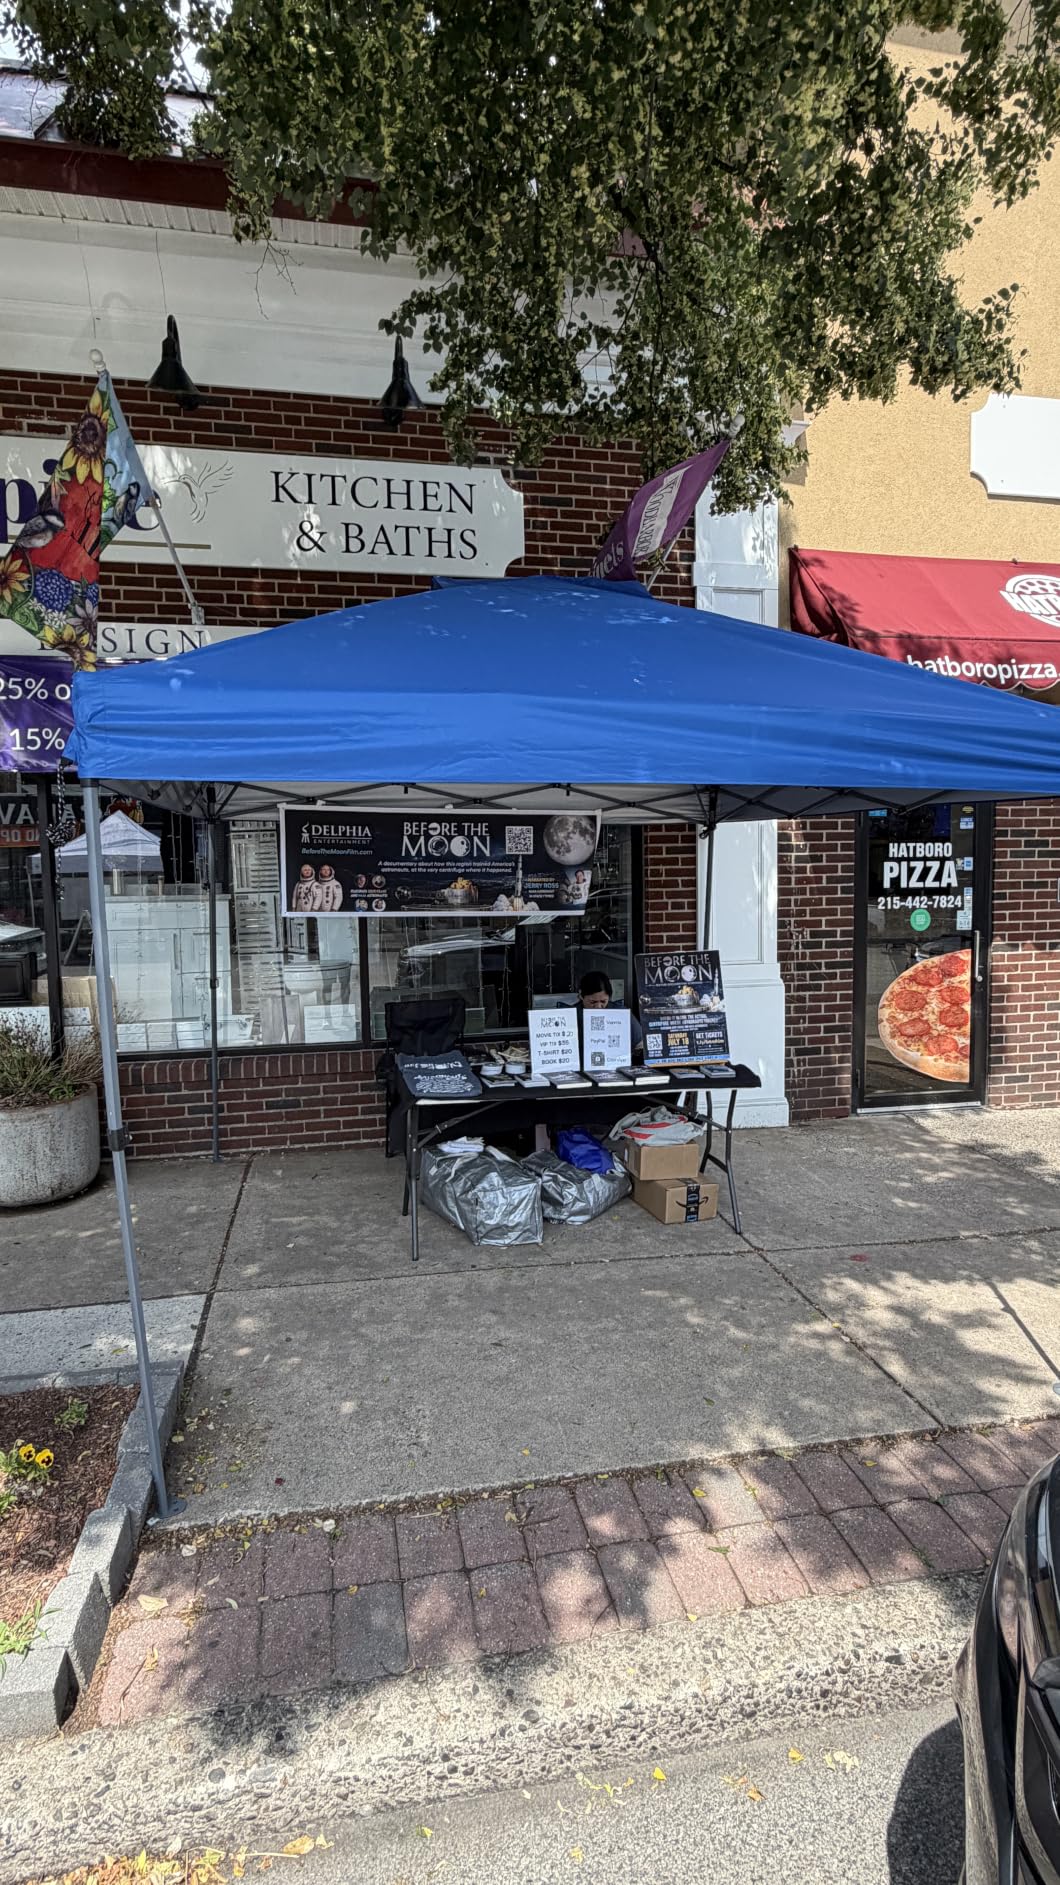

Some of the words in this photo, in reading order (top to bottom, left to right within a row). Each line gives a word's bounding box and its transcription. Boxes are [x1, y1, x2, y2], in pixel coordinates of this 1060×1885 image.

[270, 470, 477, 515] KITCHEN
[296, 520, 327, 553] &
[341, 522, 478, 560] BATHS
[9, 727, 66, 751] 15%
[311, 824, 372, 837] DELPHIA
[403, 822, 459, 836] BEFORE
[462, 822, 490, 836] THE
[401, 835, 491, 857] MOON
[888, 842, 953, 858] HATBORO
[883, 861, 958, 889] PIZZA
[877, 895, 962, 910] 215-442-7824
[644, 955, 686, 968] BEFORE
[688, 953, 711, 965] THE
[644, 964, 713, 985] MOON
